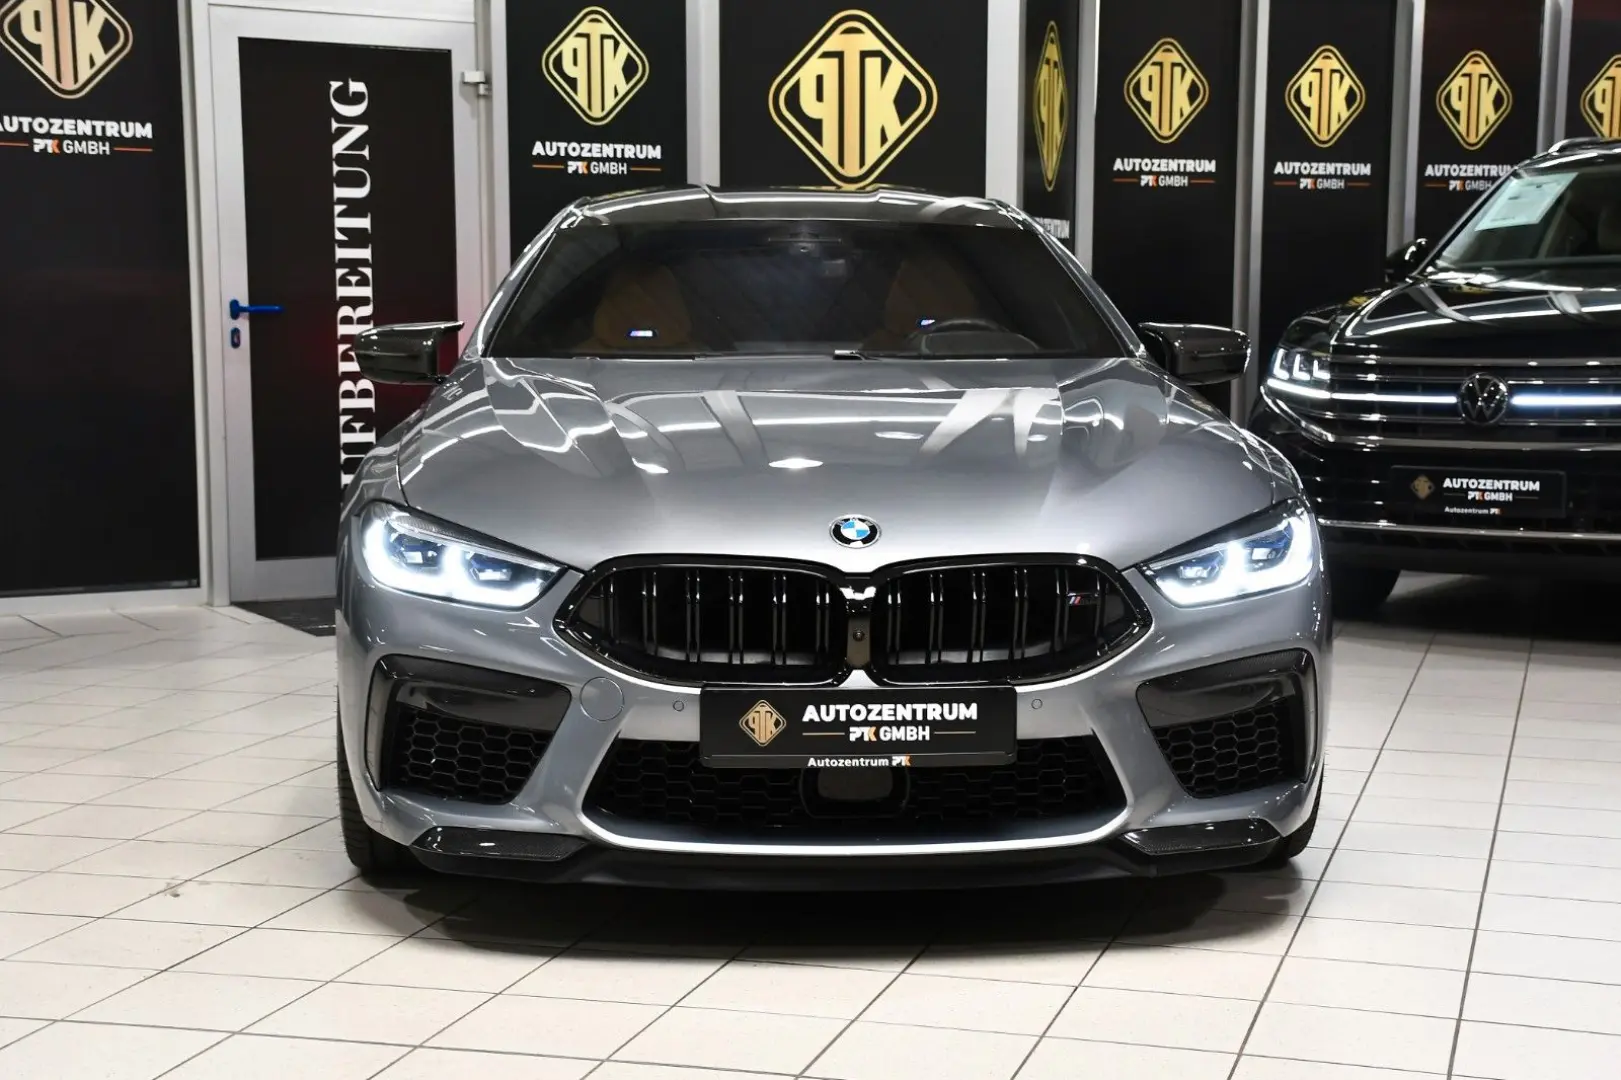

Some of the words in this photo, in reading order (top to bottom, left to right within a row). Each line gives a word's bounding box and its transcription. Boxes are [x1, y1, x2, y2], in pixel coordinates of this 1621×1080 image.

[799, 33, 905, 177] PTK
[0, 116, 153, 138] UTOZENTRUM
[33, 138, 61, 153] PTK
[62, 139, 111, 155] GMBH
[532, 141, 662, 159] AUTOZENTRUM
[567, 161, 588, 174] PTK
[590, 161, 628, 174] GMBH
[1113, 158, 1217, 172] AUTOZENTRUM
[1274, 161, 1372, 175] AUTOZENTRUM
[1158, 175, 1189, 186] GMBH
[1316, 178, 1345, 190] GMBH
[1443, 477, 1540, 491] AUTOZENTRUM
[1484, 491, 1513, 501] GMBH
[1445, 506, 1489, 515] Autozentrum
[802, 703, 978, 722] AUTOZENTRUM
[850, 727, 877, 741] PTK
[879, 726, 930, 741] GMBH
[807, 757, 889, 767] Autozentrum
